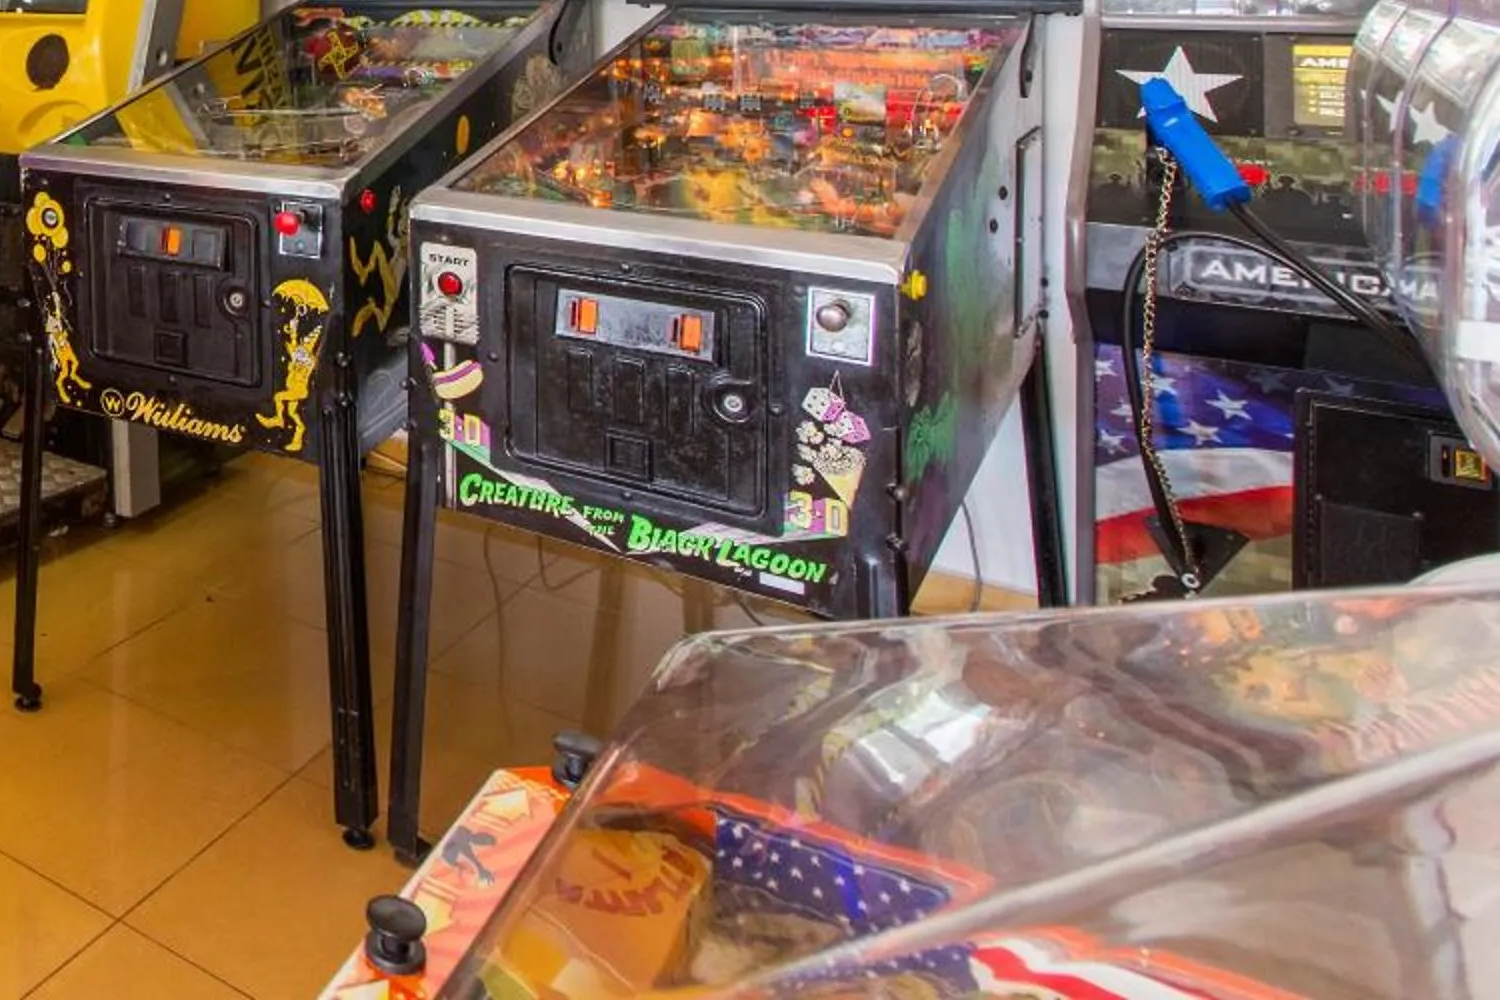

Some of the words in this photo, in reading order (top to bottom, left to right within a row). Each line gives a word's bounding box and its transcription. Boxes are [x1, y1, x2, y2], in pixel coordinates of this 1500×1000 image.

[428, 252, 471, 268] START
[125, 391, 244, 444] Williams
[582, 505, 625, 525] FROM
